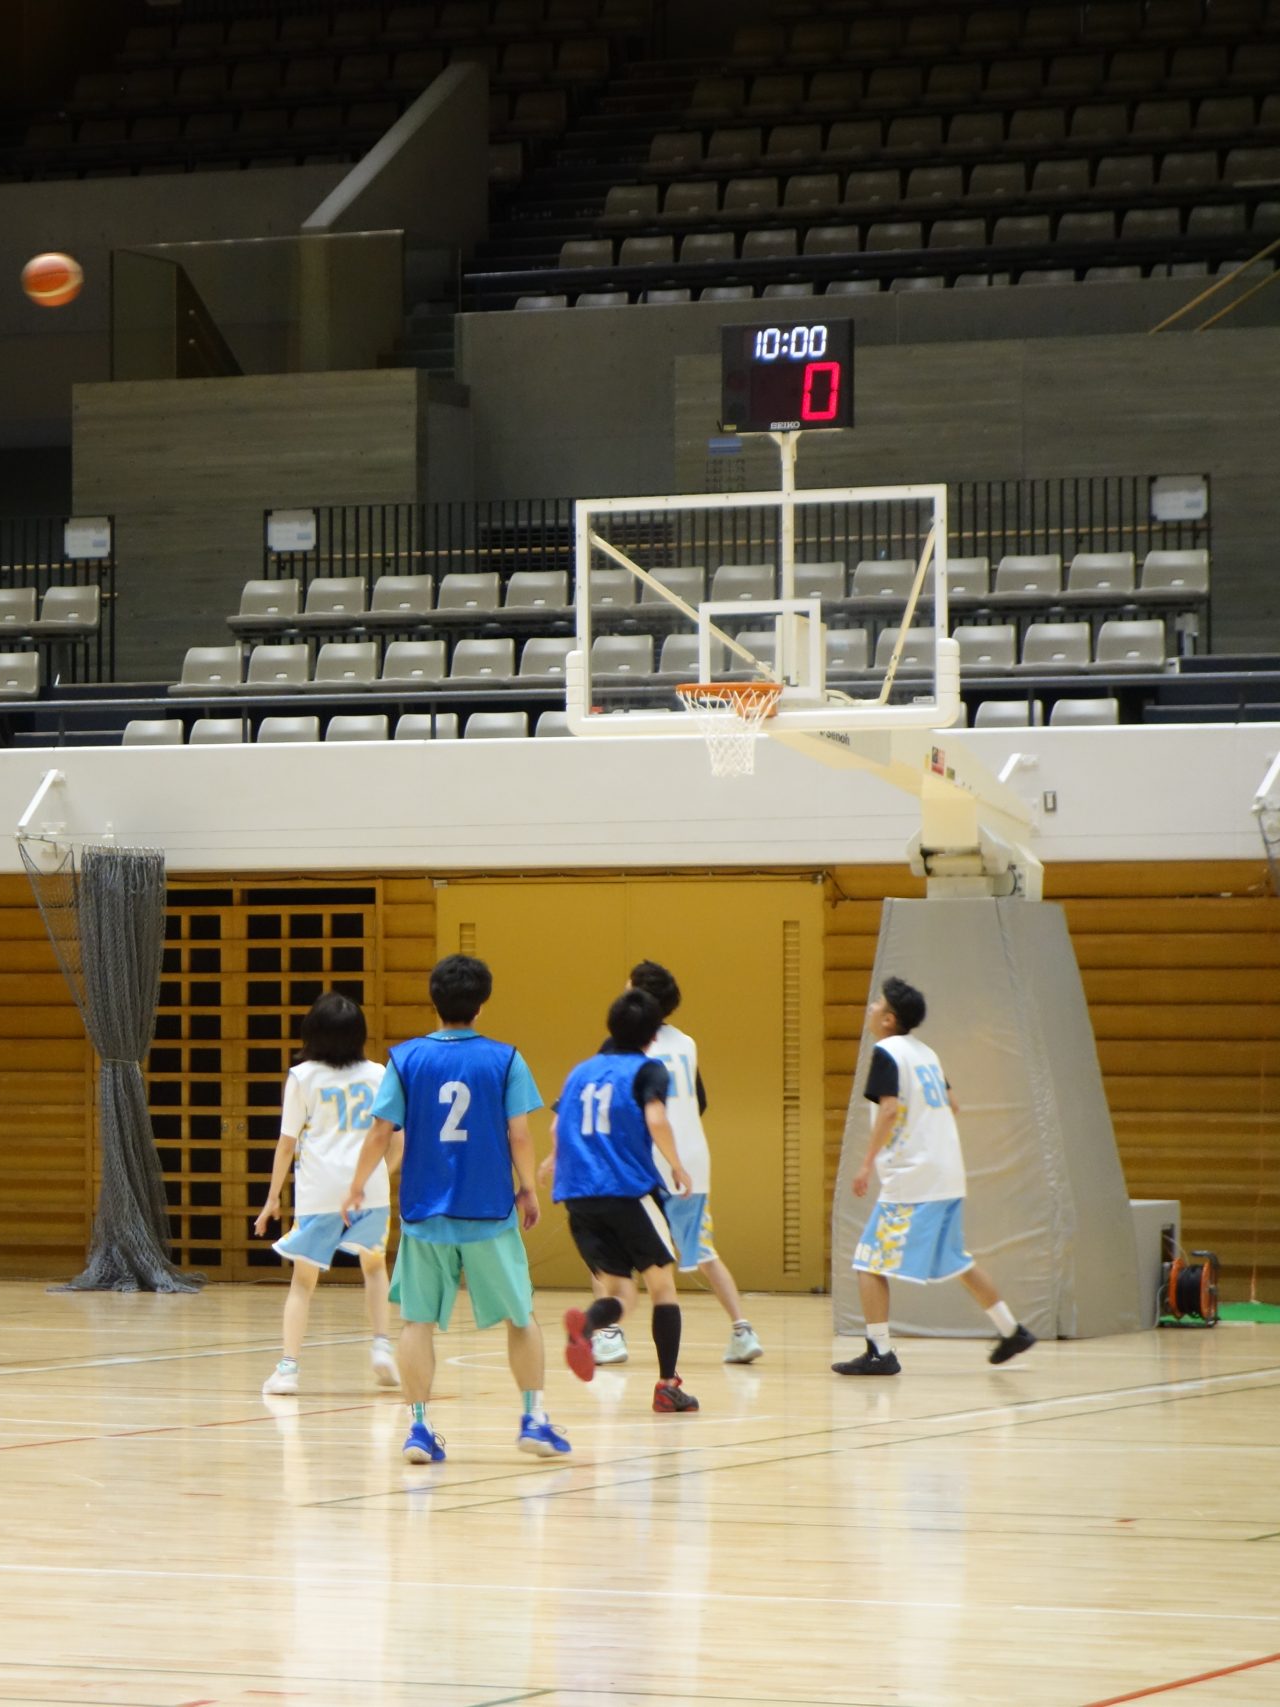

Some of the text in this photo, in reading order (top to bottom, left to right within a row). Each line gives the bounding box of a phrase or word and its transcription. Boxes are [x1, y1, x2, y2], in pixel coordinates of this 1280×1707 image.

[755, 325, 827, 359] 10:00
[801, 361, 840, 421] 0
[770, 421, 800, 430] SEIKO
[320, 1080, 374, 1132] 72
[438, 1081, 471, 1142] 2
[580, 1083, 614, 1135] 11
